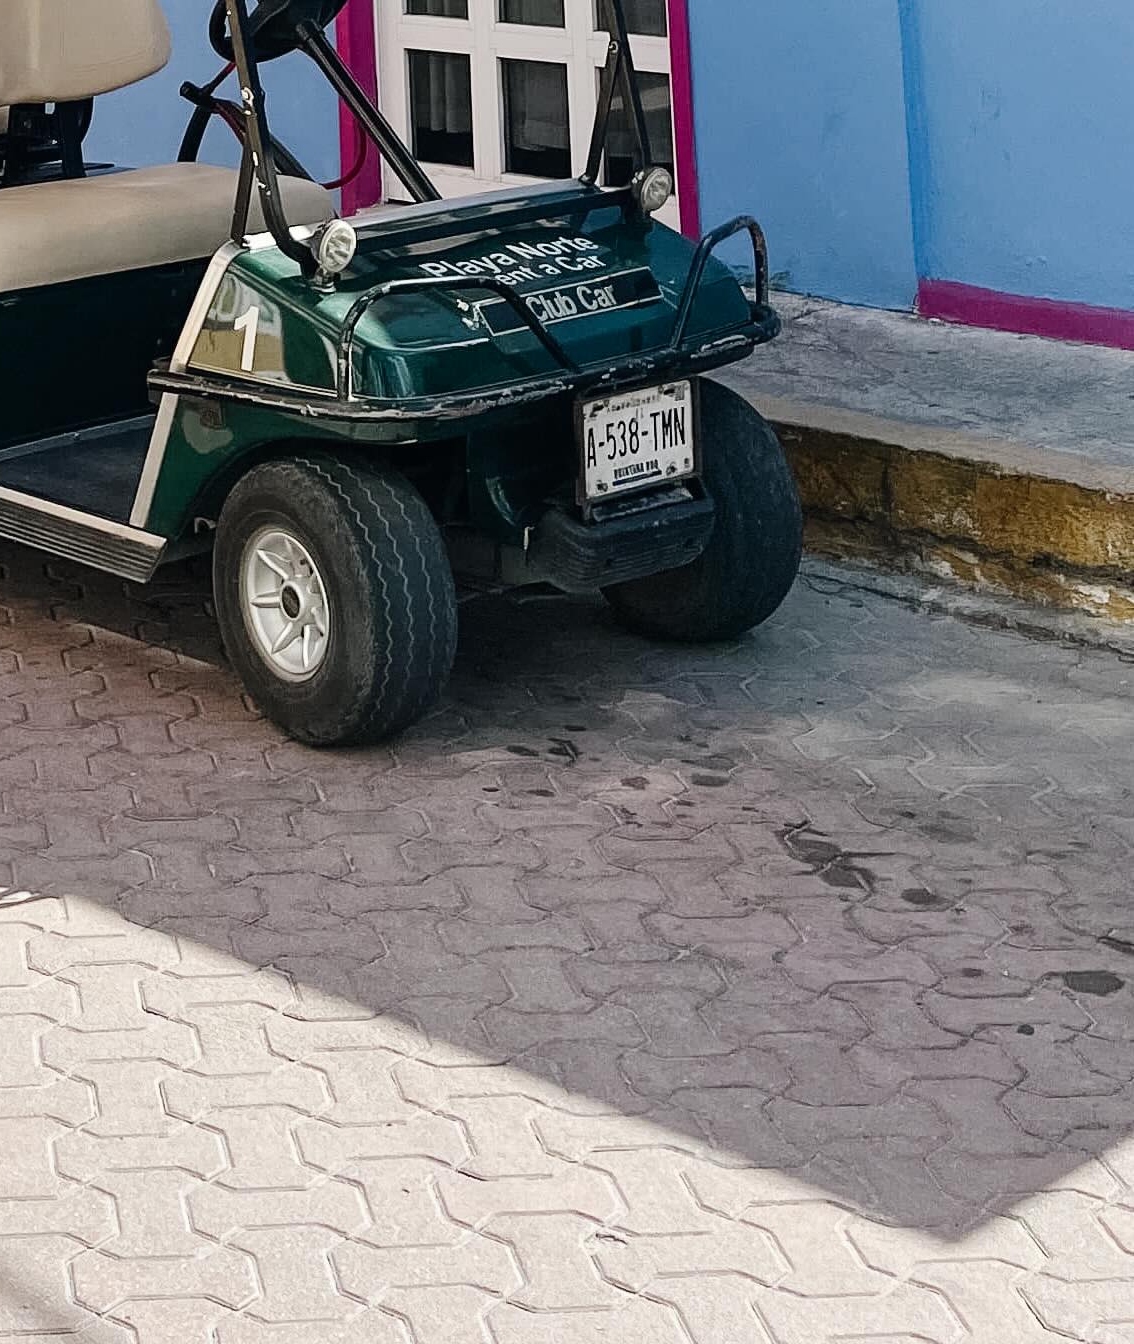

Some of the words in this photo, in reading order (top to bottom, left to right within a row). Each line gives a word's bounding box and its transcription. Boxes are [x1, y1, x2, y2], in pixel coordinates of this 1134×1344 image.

[418, 252, 519, 277] Playa
[505, 236, 599, 260] Norte
[494, 266, 543, 286] ent
[538, 263, 561, 275] a
[555, 254, 607, 271] Car
[525, 292, 578, 321] Club
[577, 285, 616, 311] Car
[234, 306, 259, 371] 1
[587, 406, 686, 469] A-538-TMN
